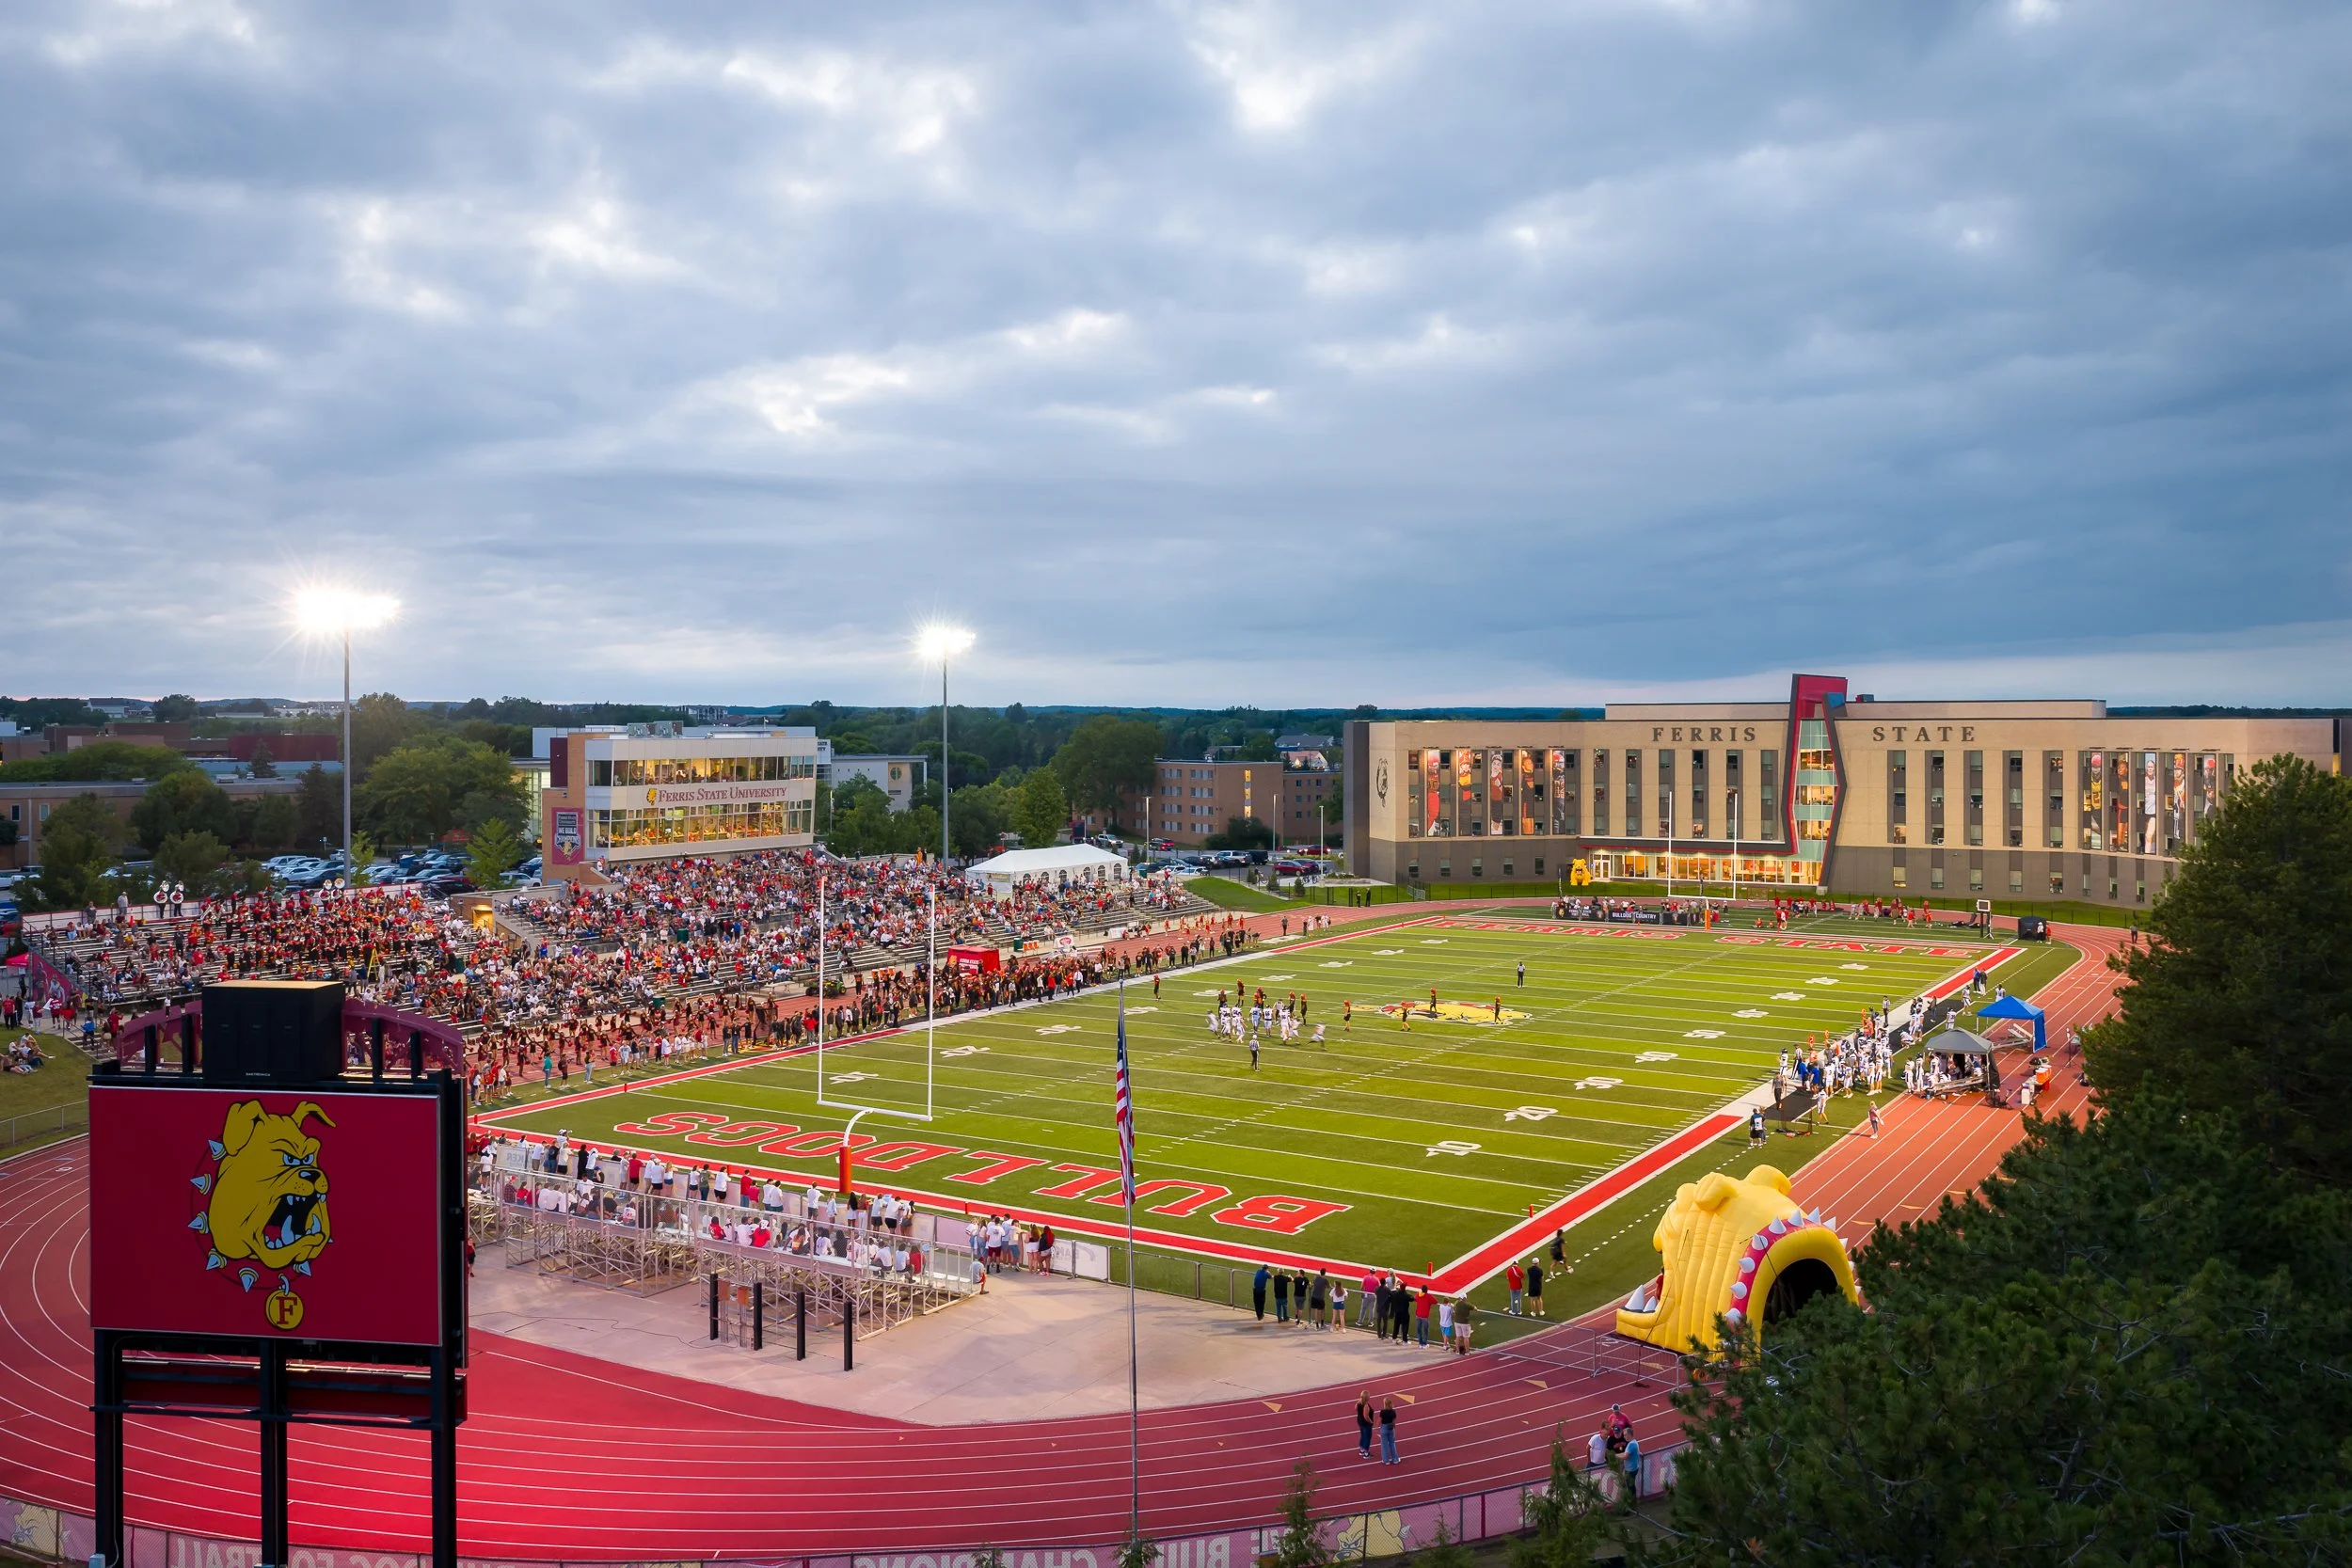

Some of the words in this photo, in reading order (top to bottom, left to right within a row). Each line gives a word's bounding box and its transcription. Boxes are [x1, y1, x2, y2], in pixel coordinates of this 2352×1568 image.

[1652, 726, 1756, 742] FERRIS
[1872, 726, 1975, 742] STATE
[659, 790, 694, 802] FERRIS
[697, 788, 727, 800] STATE
[730, 786, 787, 800] UNIVERSITY
[1425, 919, 1686, 940] FERRIS
[1714, 936, 1981, 958] STATE
[1503, 1105, 1559, 1121] 20
[1425, 1140, 1483, 1157] 10
[612, 1111, 1353, 1234] BULLDOGS
[276, 1295, 298, 1325] F
